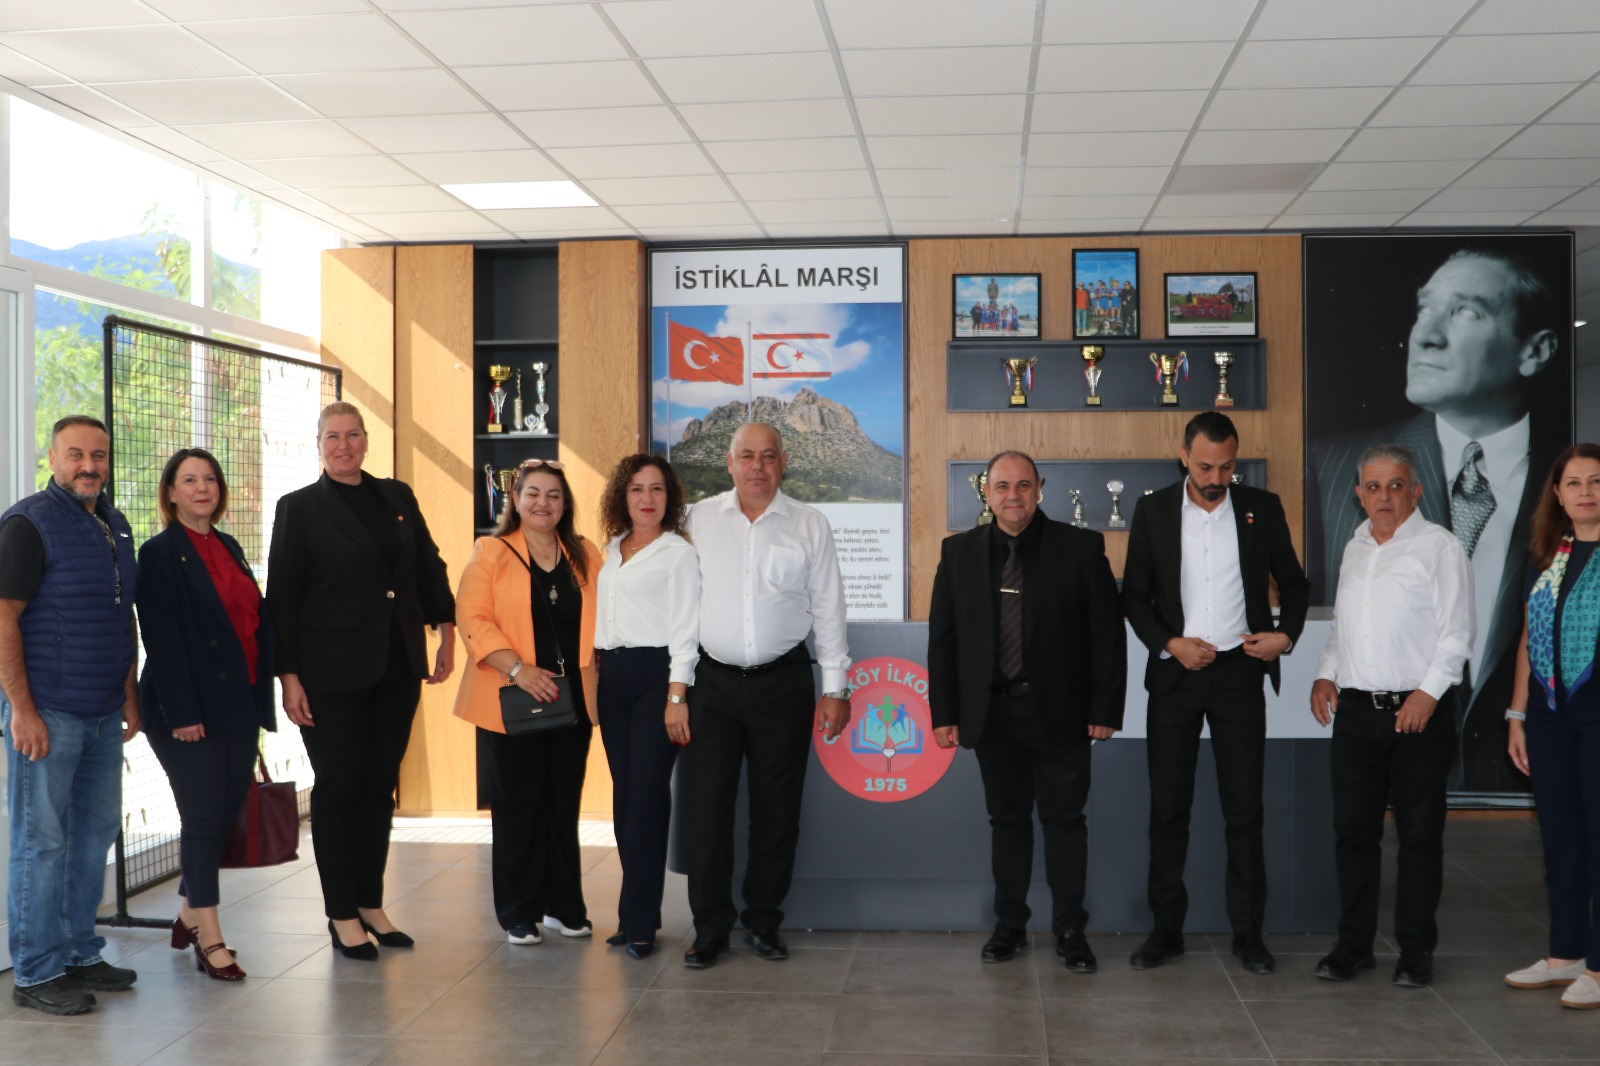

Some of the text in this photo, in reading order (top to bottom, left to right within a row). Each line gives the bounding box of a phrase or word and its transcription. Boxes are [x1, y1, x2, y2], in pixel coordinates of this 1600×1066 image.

[675, 263, 879, 291] İSTİKLÂL MARŞI
[847, 667, 881, 694] KÖY
[864, 778, 907, 792] 1975
